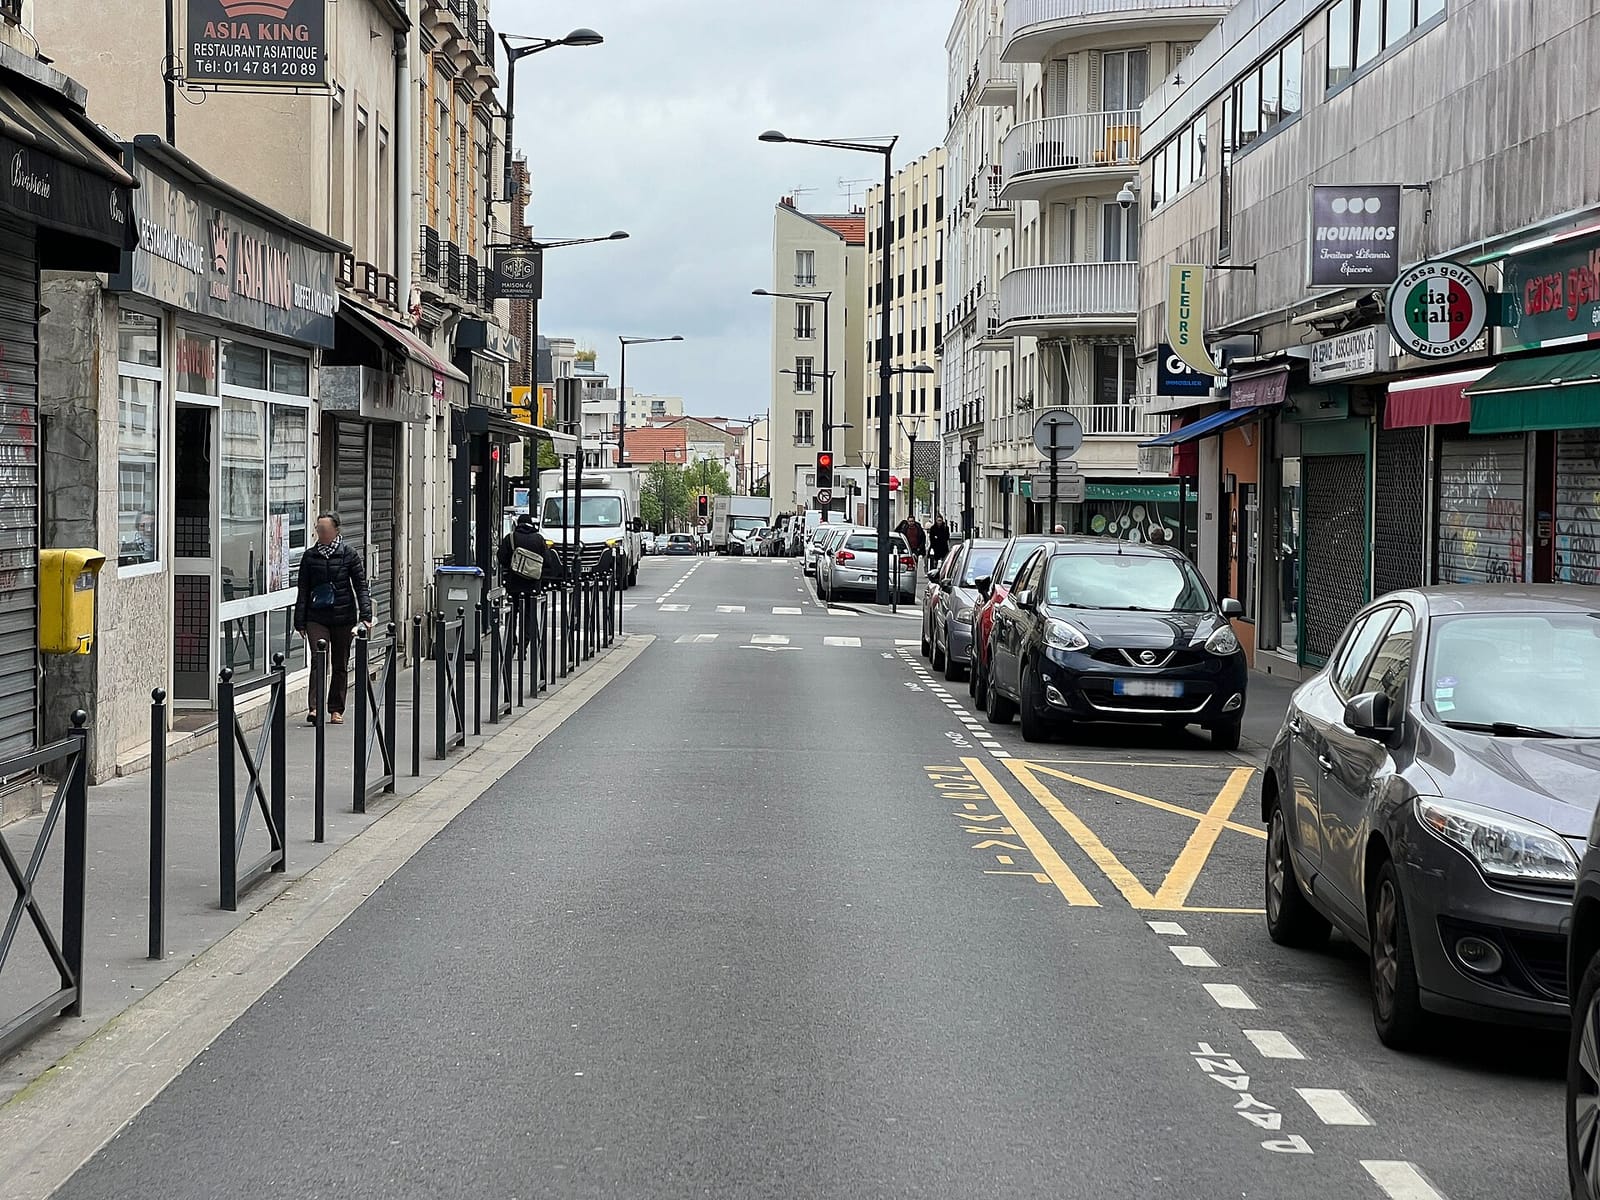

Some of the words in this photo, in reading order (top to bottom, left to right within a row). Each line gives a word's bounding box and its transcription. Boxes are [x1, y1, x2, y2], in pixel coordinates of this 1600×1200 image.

[203, 21, 251, 40] ASIA
[258, 22, 309, 42] KING
[193, 42, 262, 59] RESTAURANT
[263, 45, 318, 60] ASIATIQUE
[195, 59, 221, 74] Tél:
[224, 61, 239, 74] 01
[242, 61, 260, 75] 47
[262, 62, 278, 75] 81
[281, 62, 298, 76] 20
[300, 63, 317, 76] 89
[10, 148, 51, 199] Brasserie
[1316, 226, 1396, 241] HOUMMOS
[141, 217, 177, 263] RESTAURANT
[177, 235, 204, 275] ASIATIQUE
[1320, 248, 1354, 259] Traiteur
[1355, 247, 1391, 259] Libanais
[236, 231, 264, 302] ASIA
[264, 240, 292, 311] KING
[1340, 260, 1374, 277] Épicerie
[1403, 266, 1436, 288] casa
[1440, 266, 1473, 287] gelfi
[294, 282, 311, 310] BUFFET
[1419, 289, 1459, 305] ciao
[1524, 271, 1563, 317] casa
[1178, 270, 1192, 345] FLEURS
[1413, 305, 1464, 323] italia
[1411, 337, 1468, 355] épicerie
